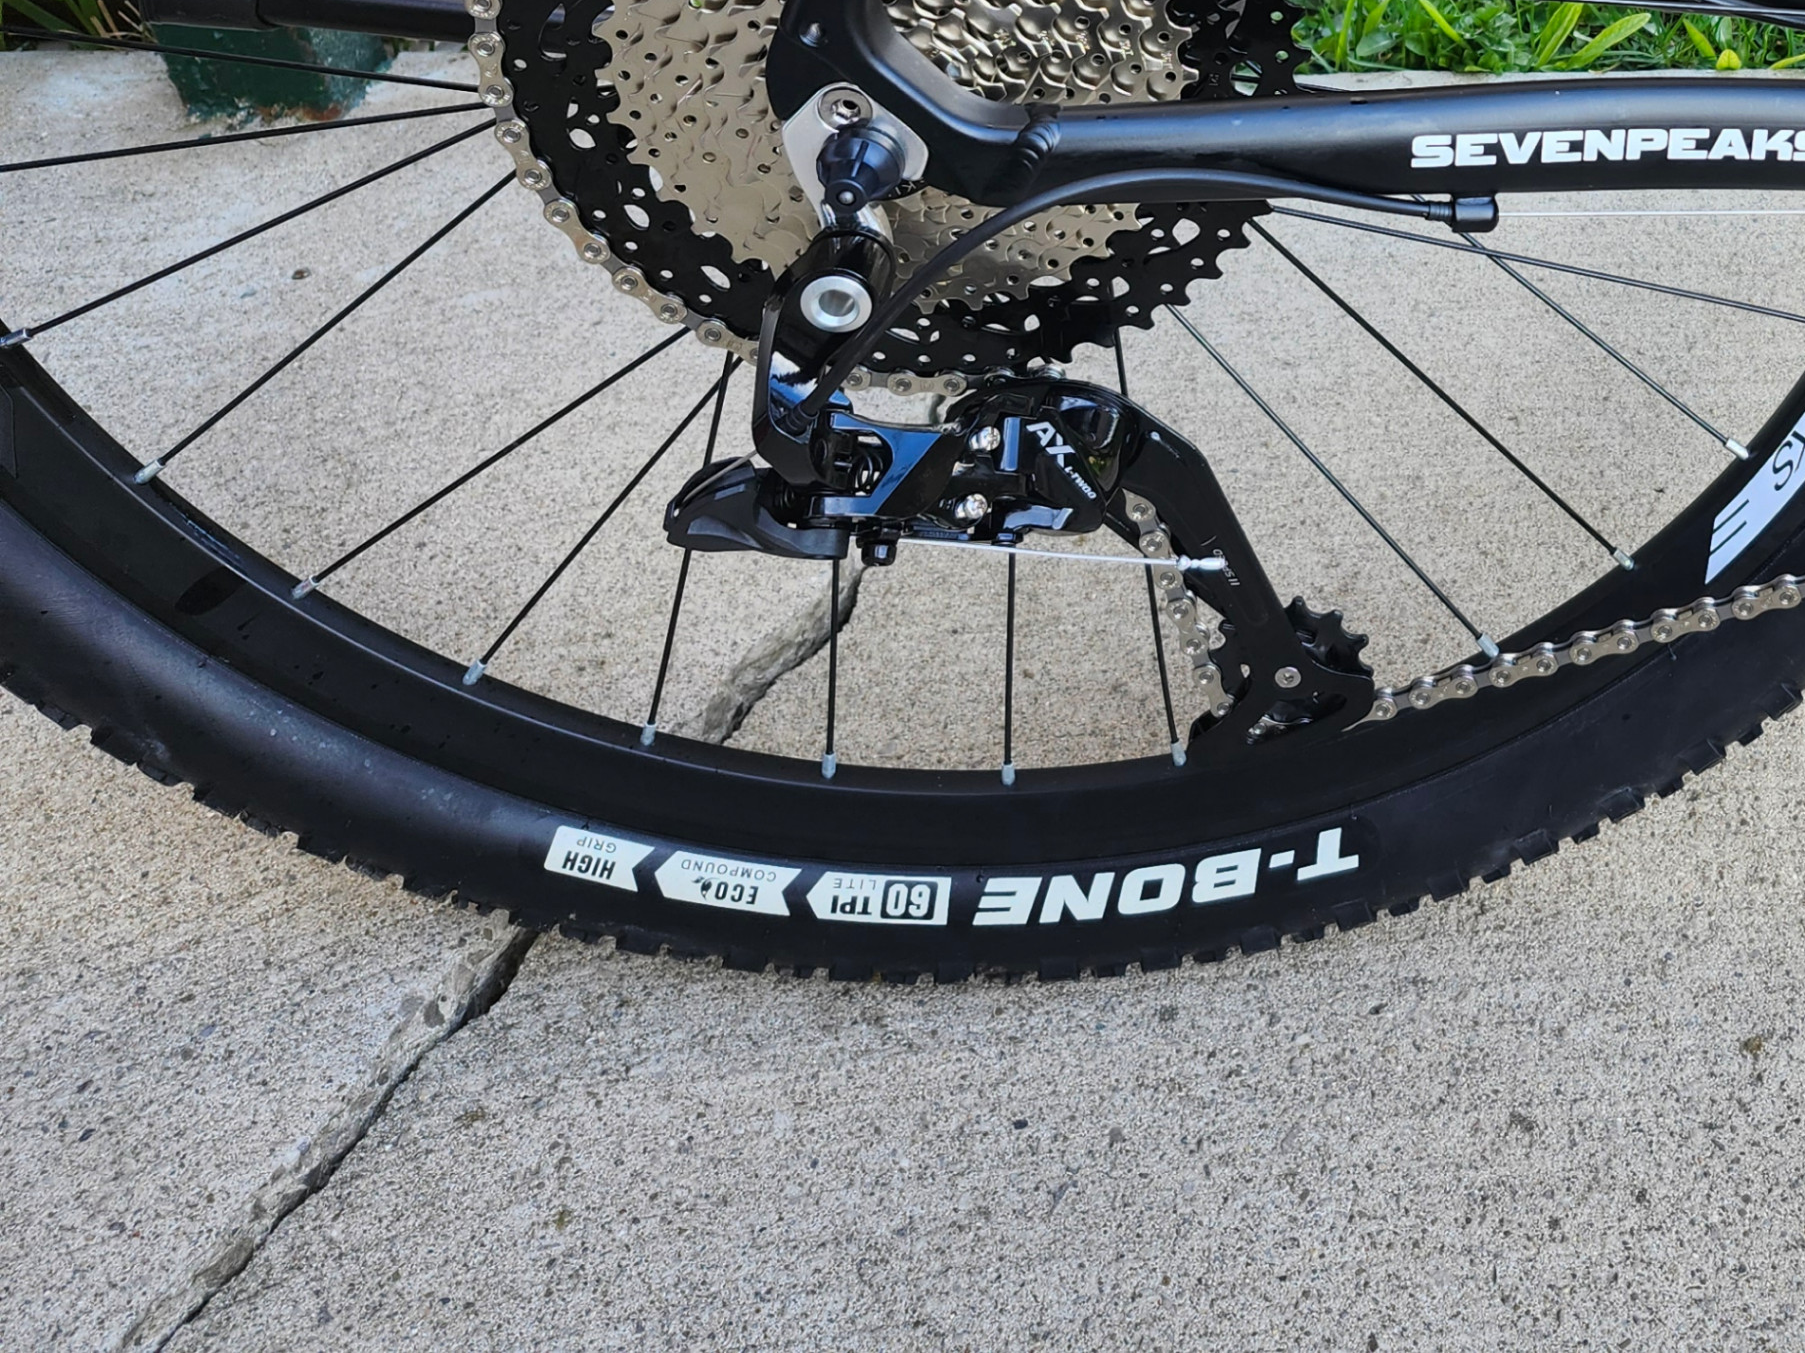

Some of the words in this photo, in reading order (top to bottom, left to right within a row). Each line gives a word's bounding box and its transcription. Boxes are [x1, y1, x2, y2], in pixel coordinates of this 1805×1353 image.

[1026, 421, 1076, 468] AX
[576, 837, 617, 854] GRIP
[562, 850, 616, 881] HIGH
[680, 858, 777, 883] COMPOUND
[972, 826, 1361, 927] T-BONE
[714, 884, 759, 905] ECO
[833, 877, 877, 891] LITE
[830, 895, 872, 916] TPI
[884, 881, 934, 918] 60
